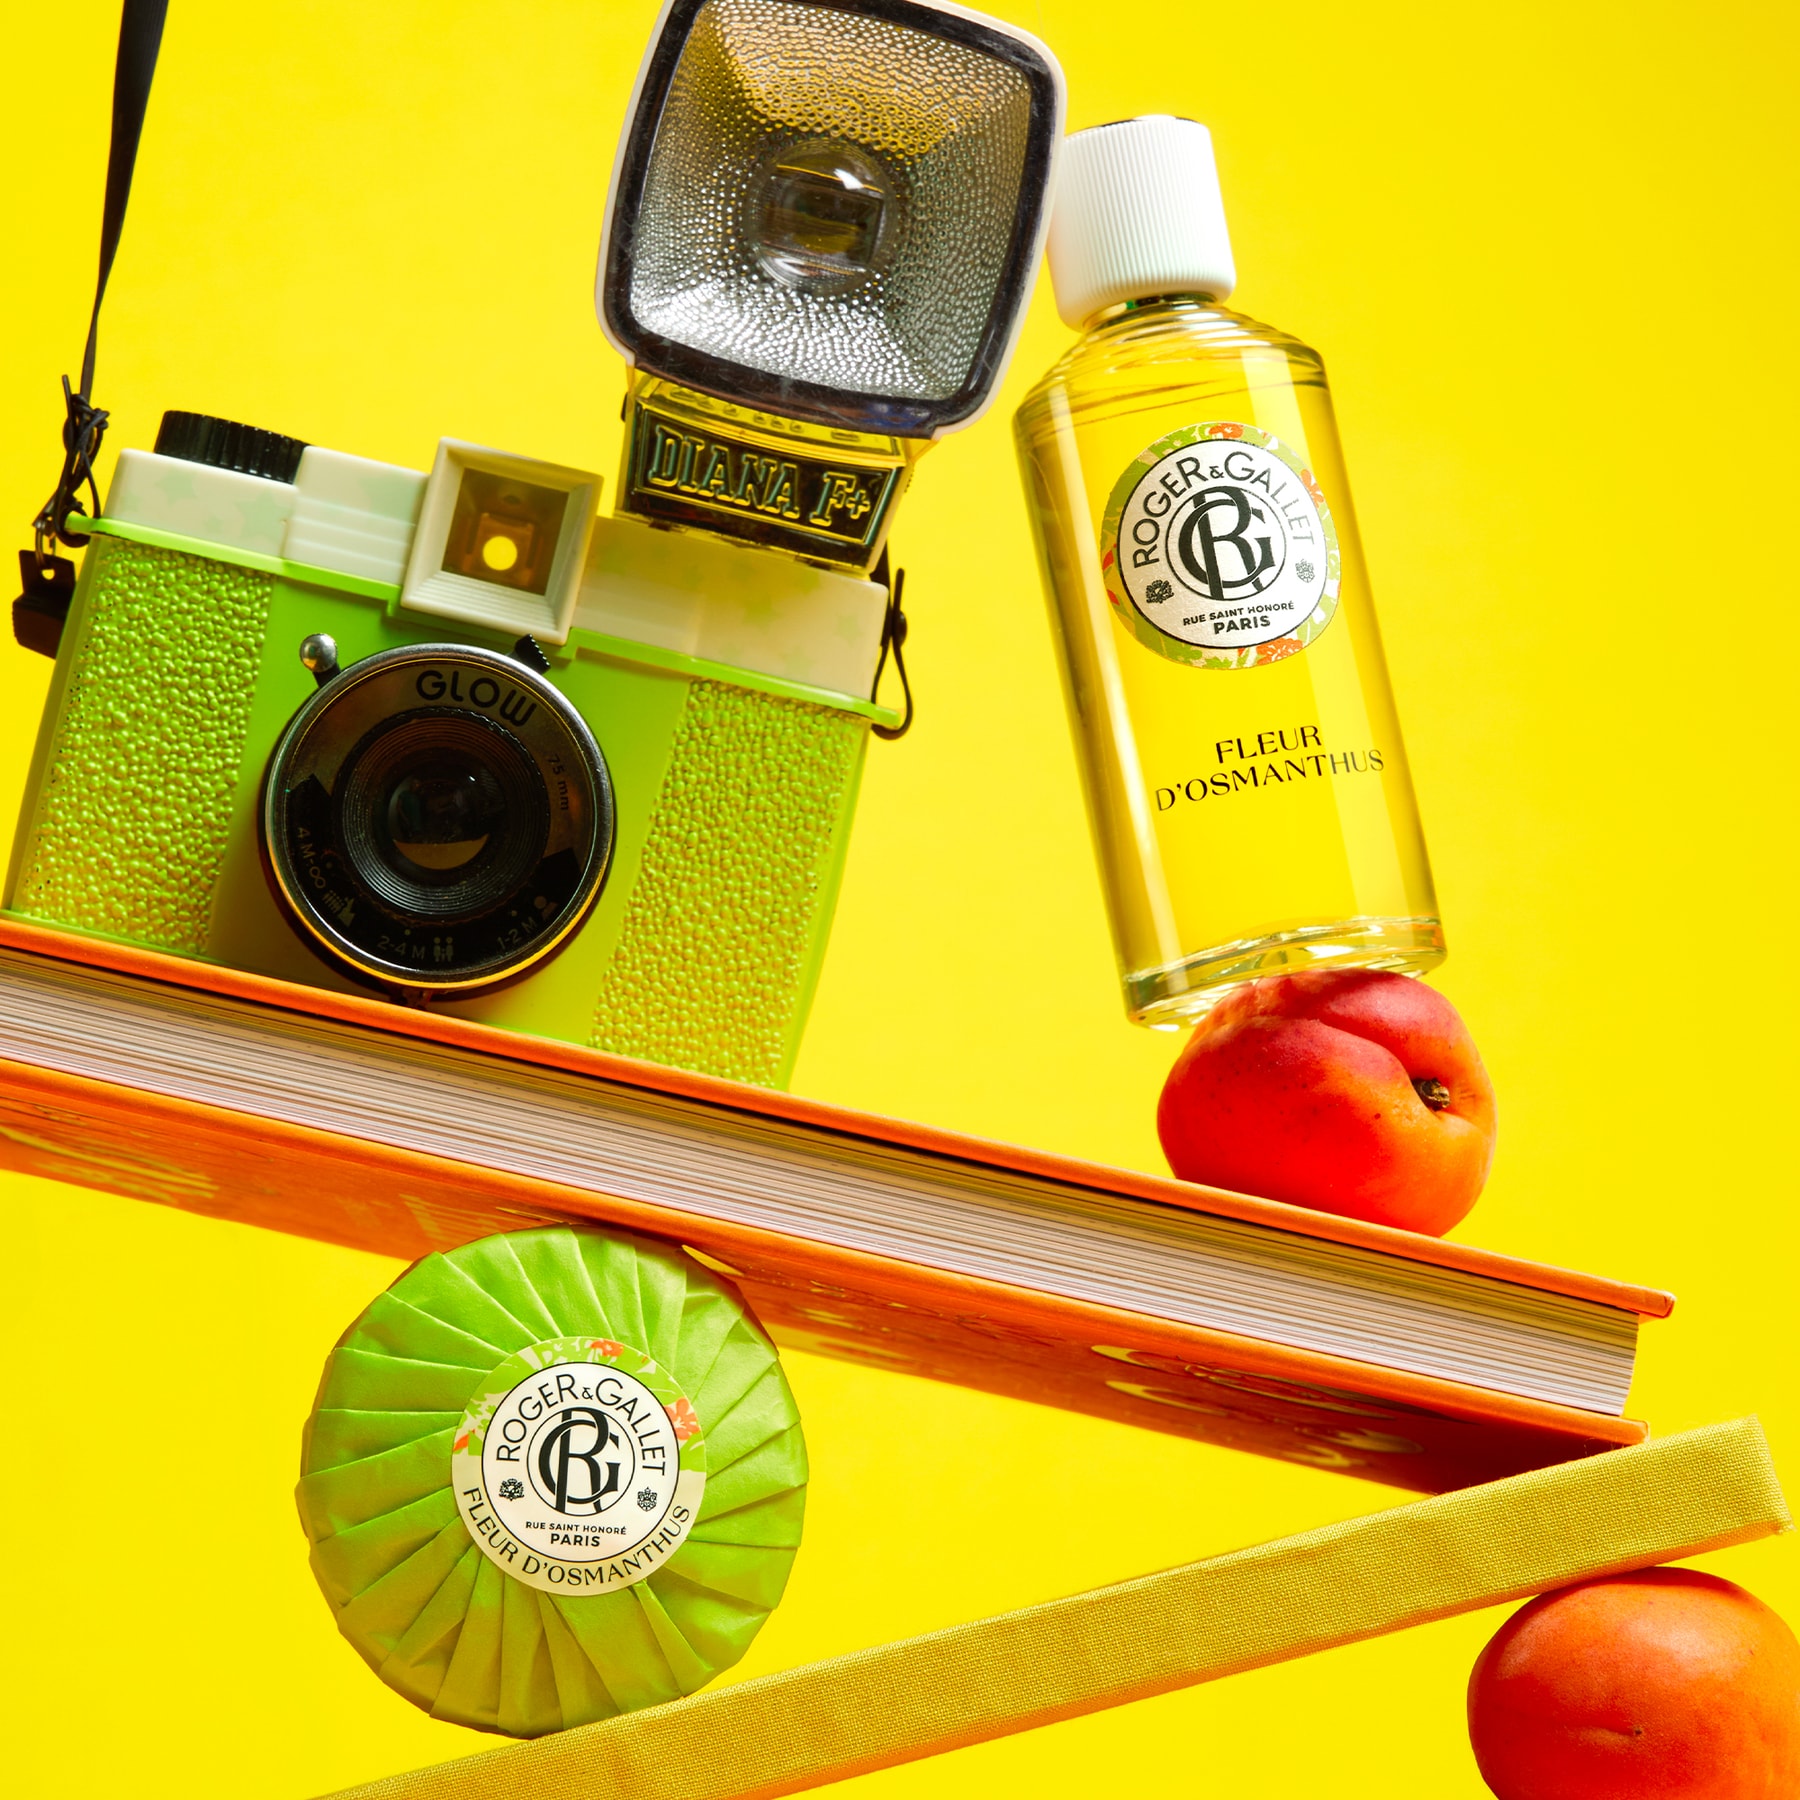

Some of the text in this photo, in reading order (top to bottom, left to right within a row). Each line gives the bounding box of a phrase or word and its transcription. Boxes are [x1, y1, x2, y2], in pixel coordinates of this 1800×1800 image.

[648, 424, 871, 527] DIANA F+
[1182, 601, 1294, 626] RUE SAINT HONORÉ
[1213, 615, 1271, 635] PARIS
[415, 670, 537, 727] GLOW
[1215, 725, 1322, 764] FLEUR
[548, 754, 570, 811] 75 mm
[1155, 749, 1384, 811] D’OSMANTHUS
[463, 1487, 690, 1586] FLEUR D’OSMANTHUS
[525, 1521, 627, 1535] RUE SAINT HONORÉ
[550, 1532, 600, 1547] PARIS
